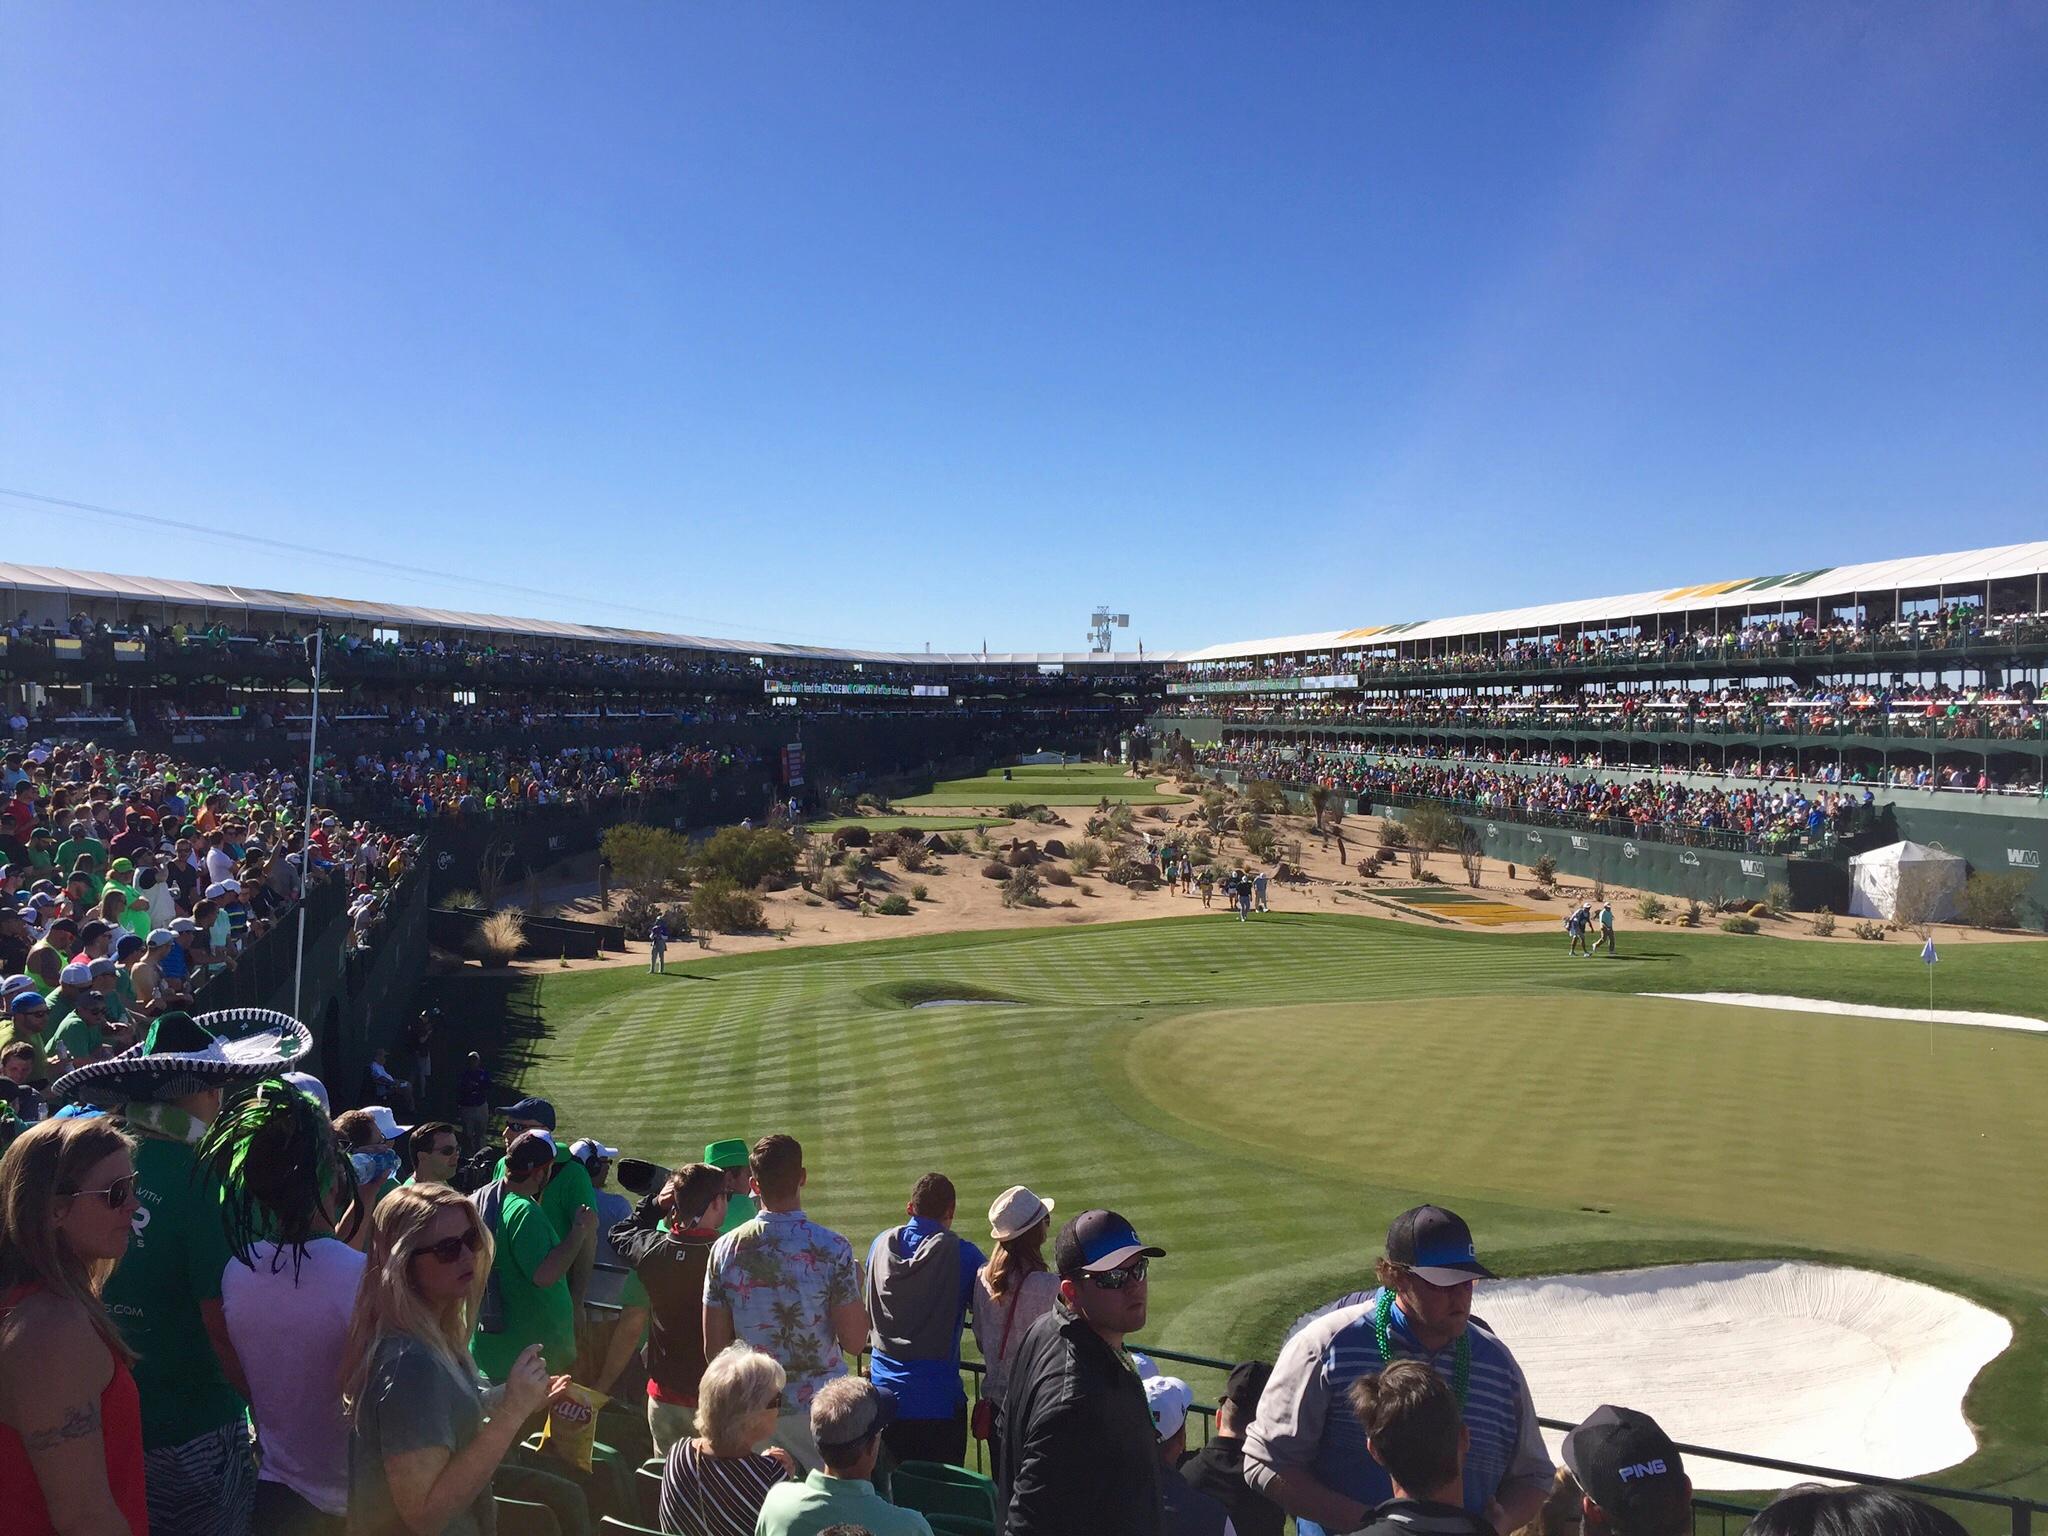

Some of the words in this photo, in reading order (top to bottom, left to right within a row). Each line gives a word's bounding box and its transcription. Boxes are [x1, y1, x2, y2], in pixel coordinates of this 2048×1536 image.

[2007, 848, 2040, 865] WM
[1741, 859, 1765, 874] WM
[1618, 1459, 1667, 1483] PING
